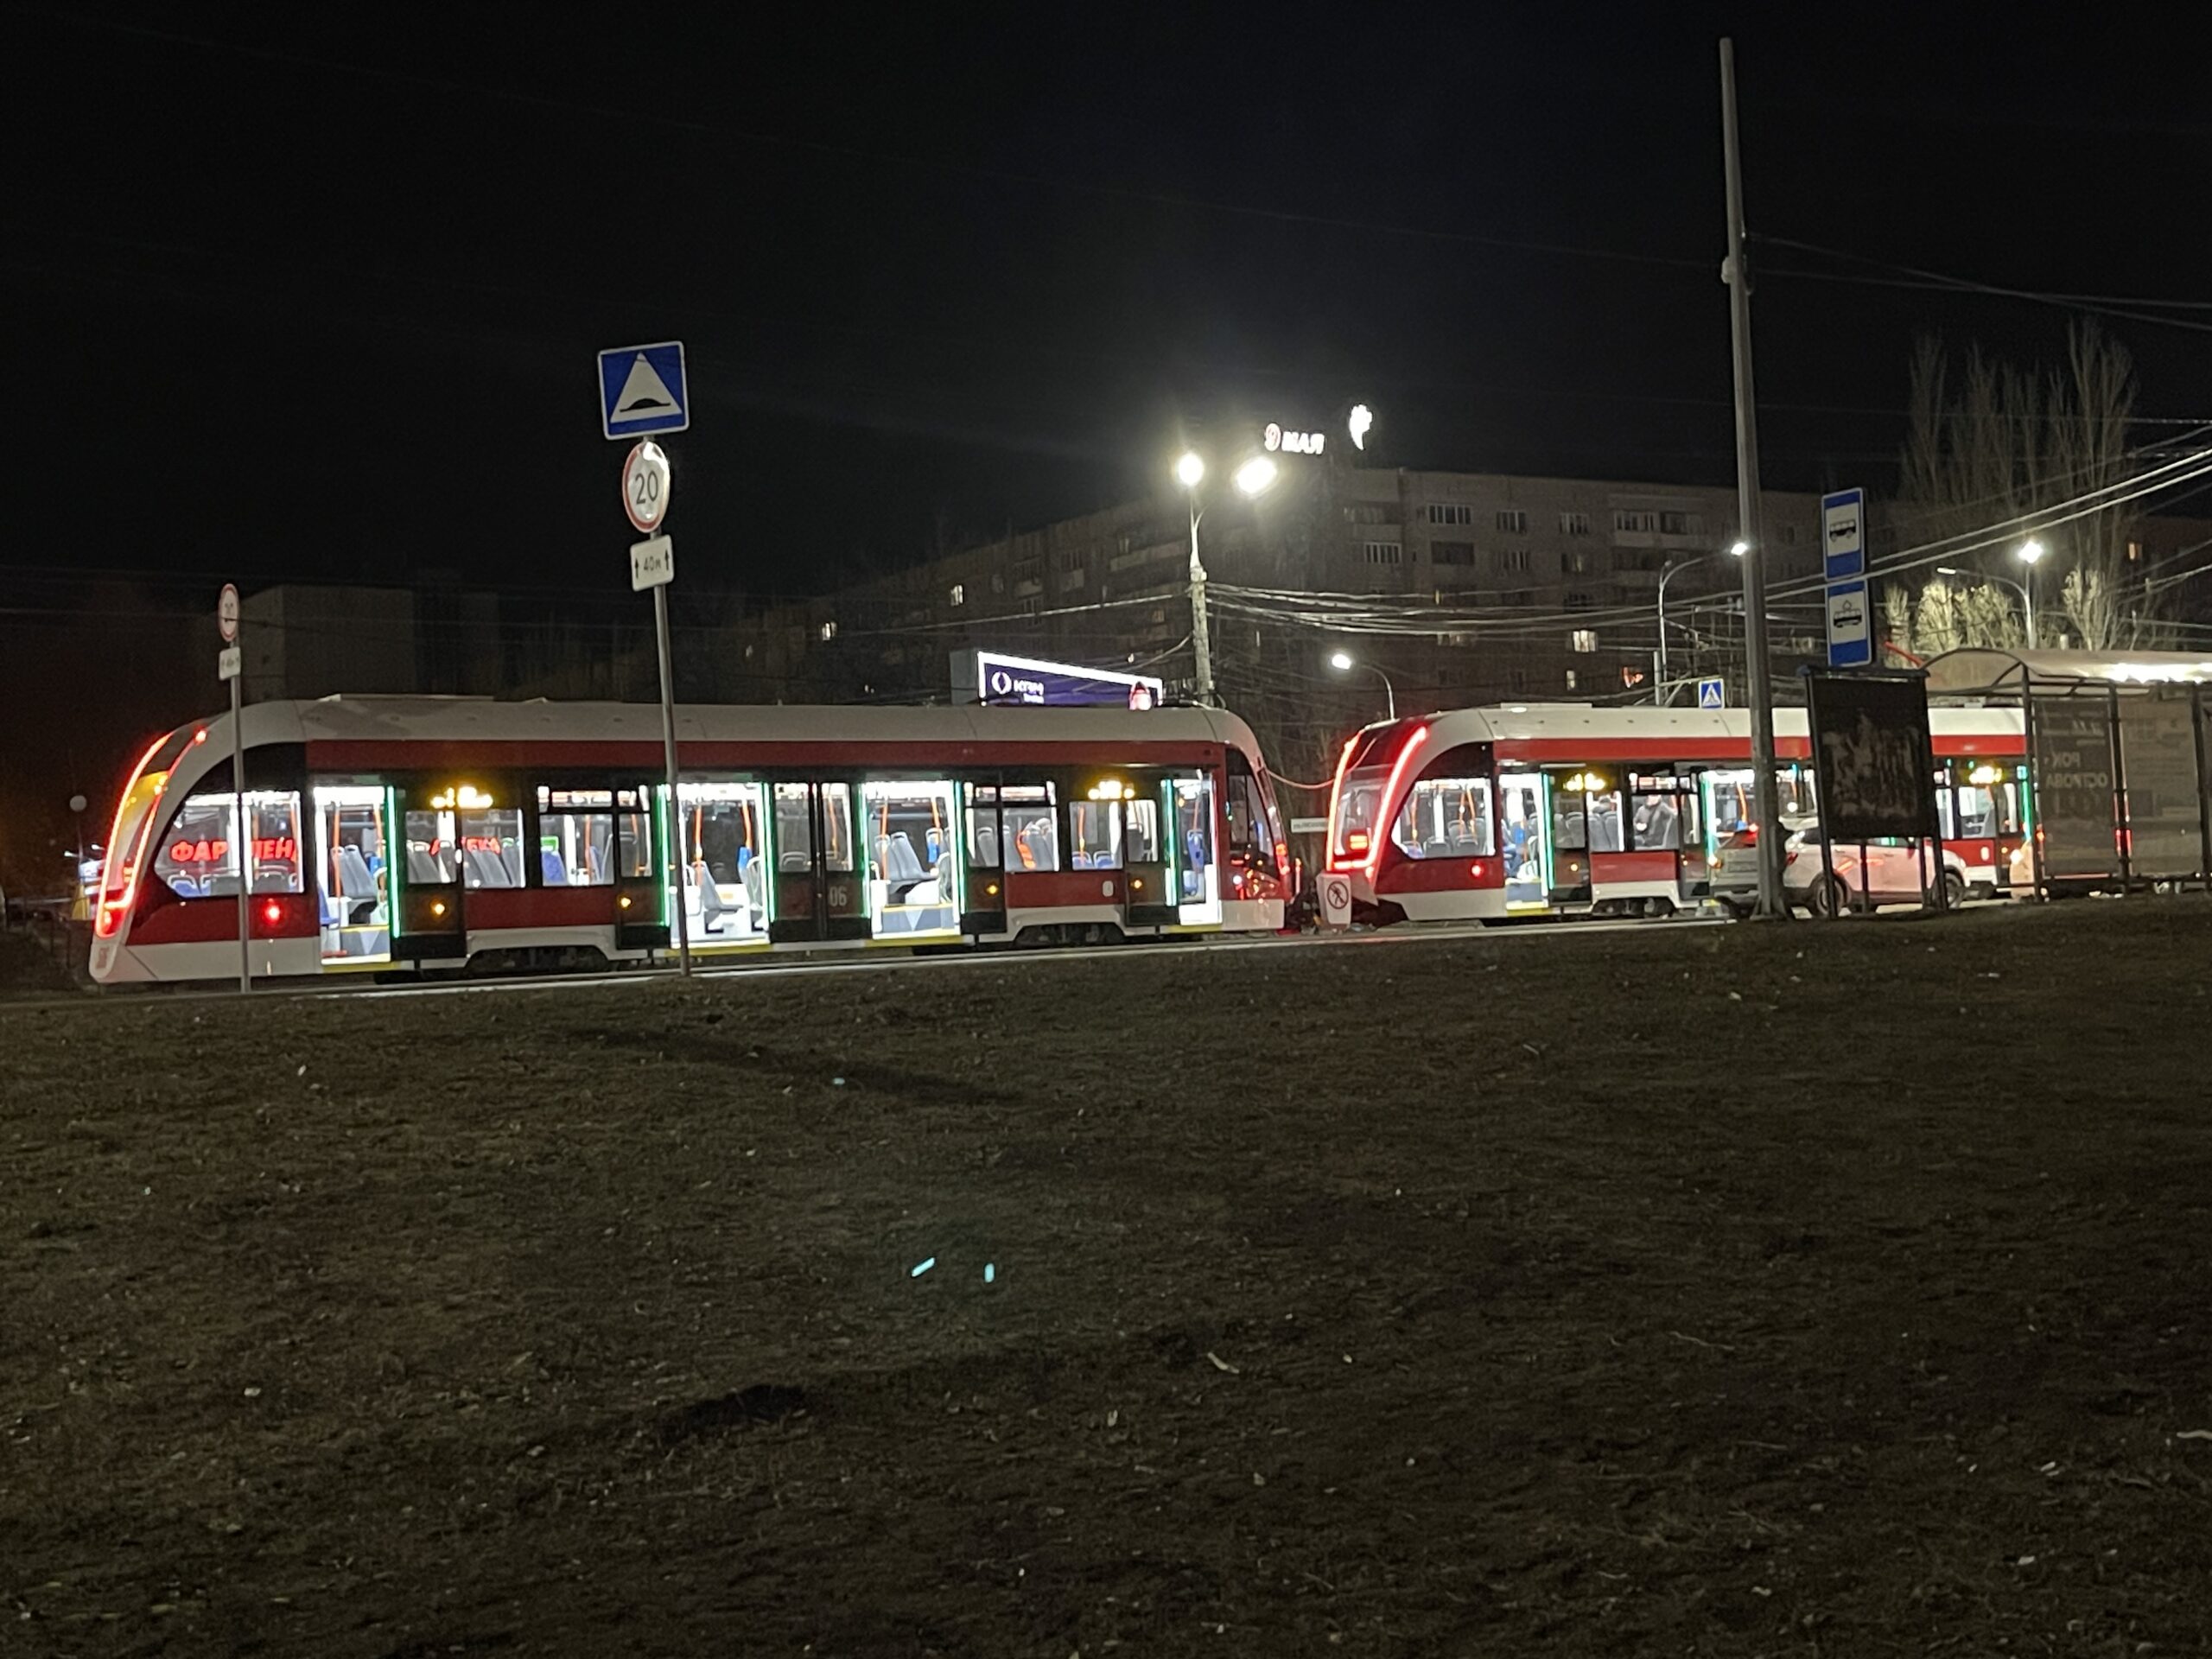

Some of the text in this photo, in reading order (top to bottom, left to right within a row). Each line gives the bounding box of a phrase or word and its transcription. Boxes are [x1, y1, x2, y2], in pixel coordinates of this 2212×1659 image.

[1265, 423, 1281, 451] 9
[634, 470, 659, 505] 20
[829, 886, 848, 907] 06
